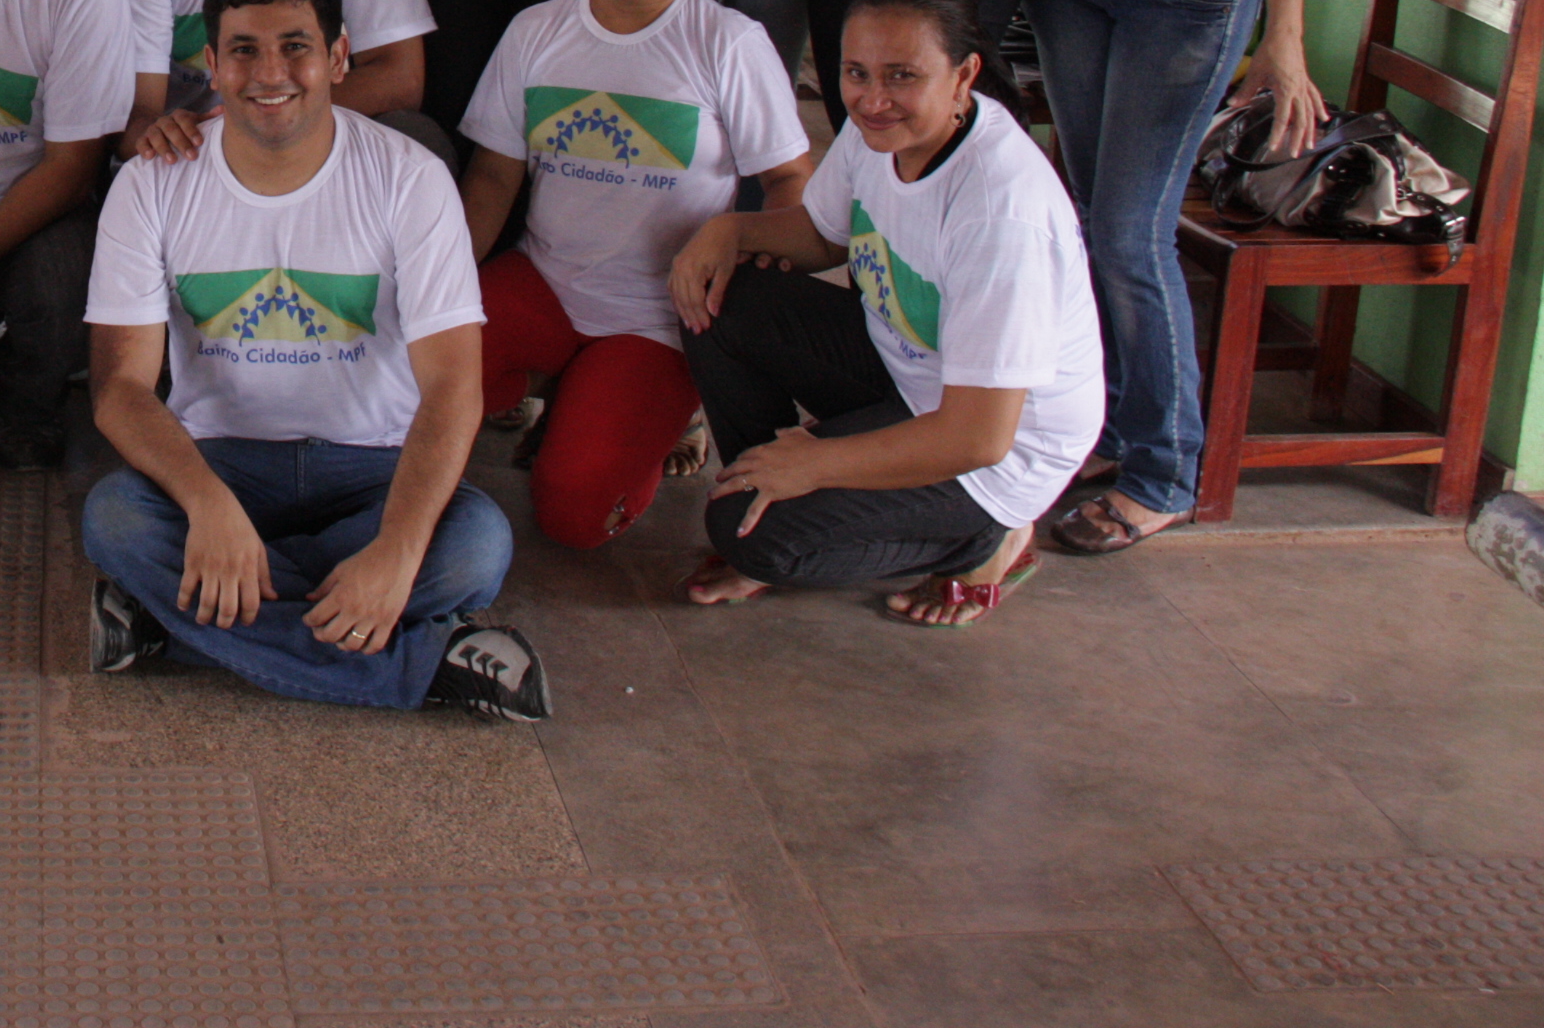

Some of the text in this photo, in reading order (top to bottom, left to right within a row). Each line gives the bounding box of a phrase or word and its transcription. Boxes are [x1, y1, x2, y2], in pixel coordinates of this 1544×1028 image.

[561, 162, 624, 185] Cidadão
[642, 174, 677, 191] MPF
[197, 340, 239, 363] Bairro
[246, 347, 320, 365] Cidadão
[339, 341, 366, 363] MPF
